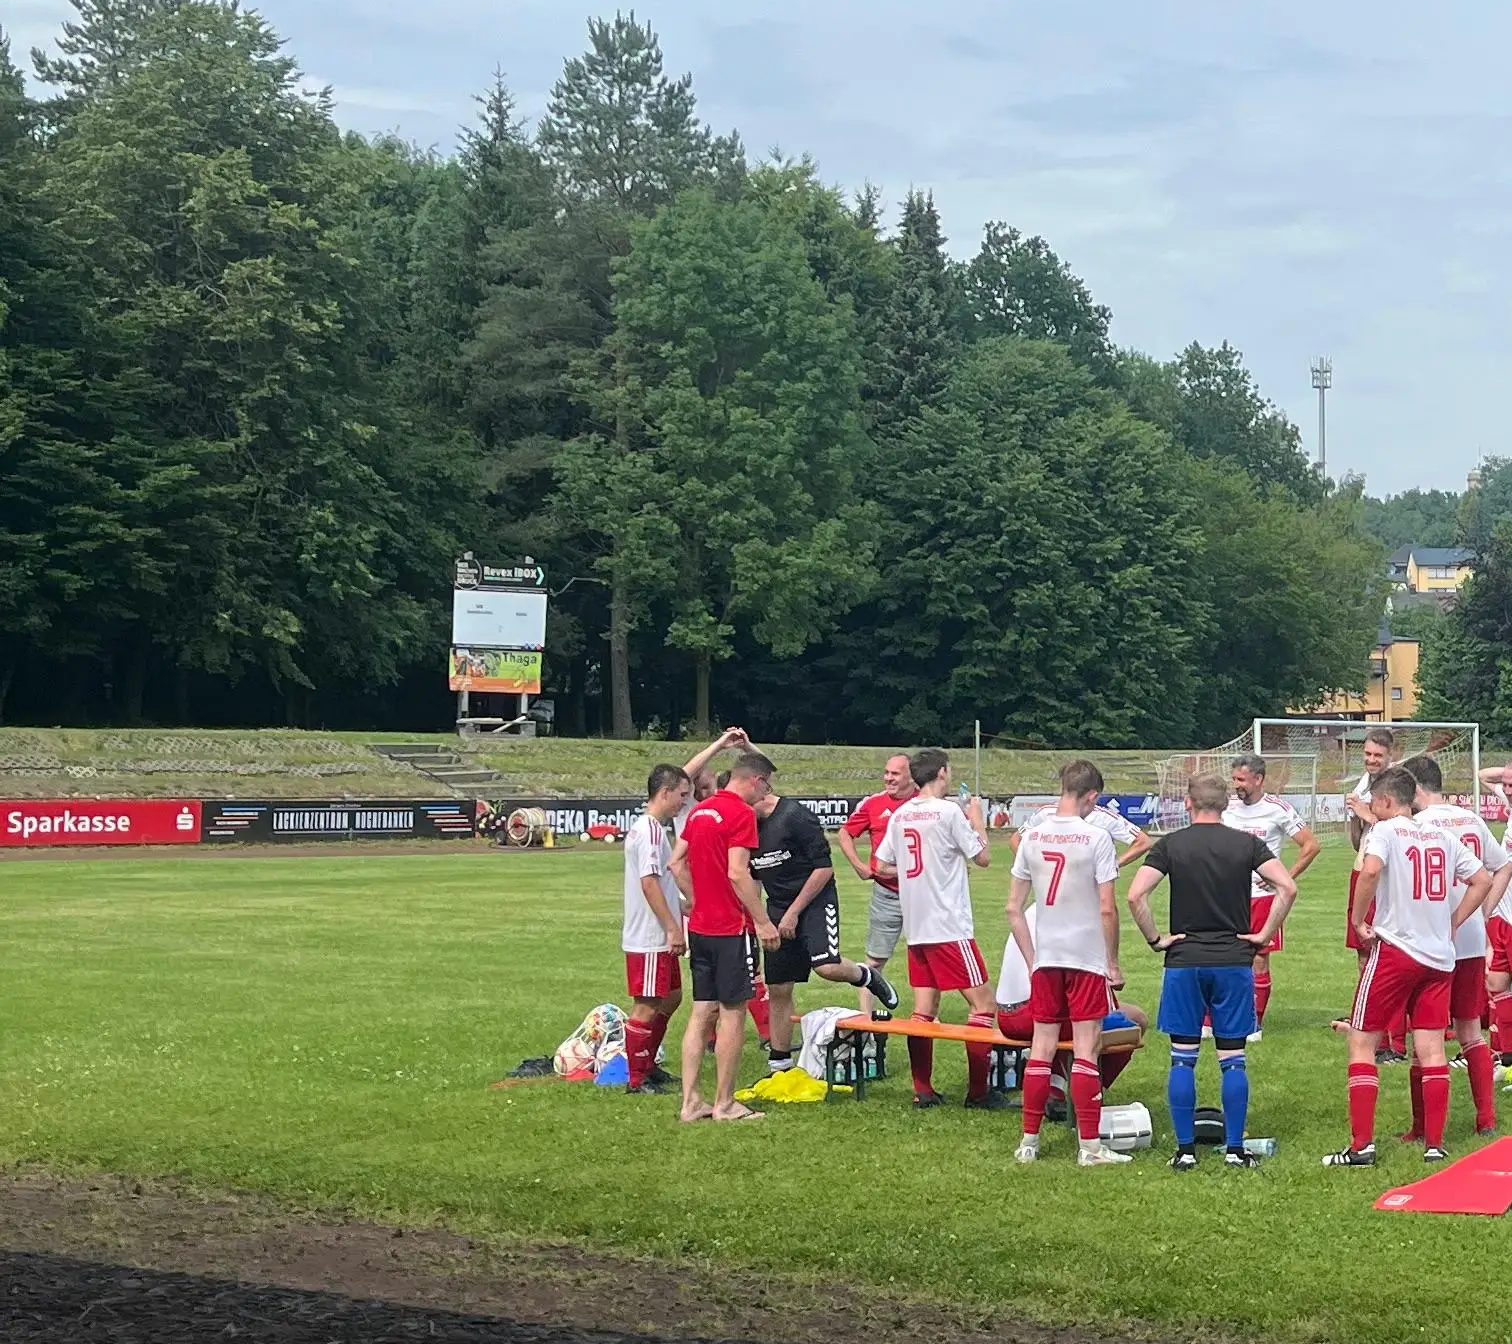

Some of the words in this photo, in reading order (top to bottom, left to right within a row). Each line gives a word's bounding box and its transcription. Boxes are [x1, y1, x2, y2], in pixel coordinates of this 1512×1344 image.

[483, 566, 512, 577] Revex
[502, 652, 537, 666] Thaga
[799, 800, 849, 813] MANN
[7, 810, 131, 838] Sparkasse
[547, 809, 584, 833] DEKA
[903, 828, 924, 879] 3
[1041, 851, 1066, 906] 7
[1405, 845, 1446, 902] 18
